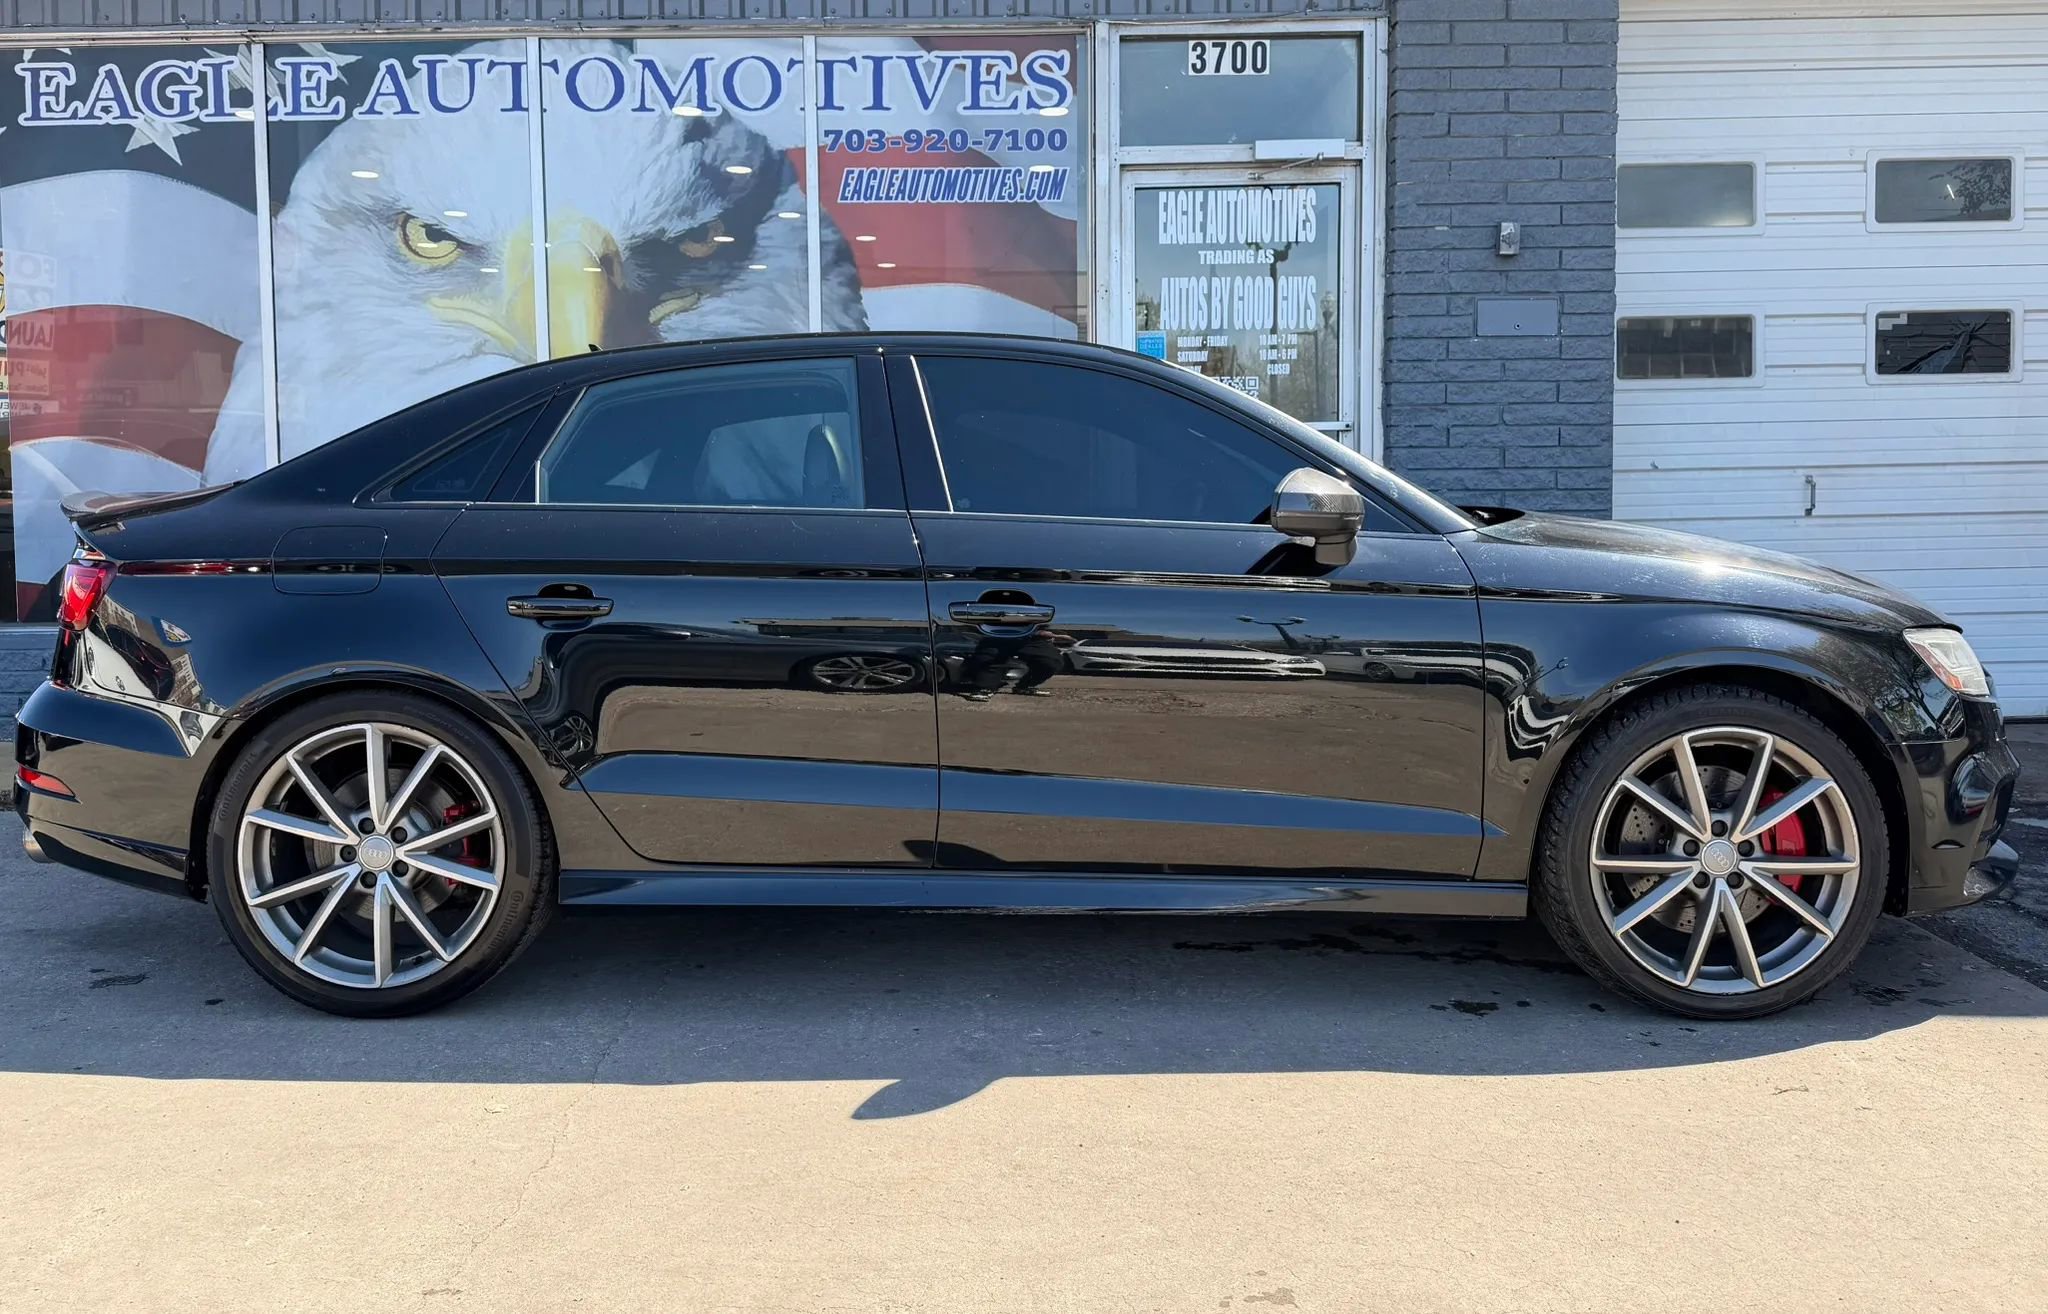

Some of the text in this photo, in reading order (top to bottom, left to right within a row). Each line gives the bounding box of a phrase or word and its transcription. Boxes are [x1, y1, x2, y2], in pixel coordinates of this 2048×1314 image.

[1190, 40, 1268, 75] 3700
[18, 54, 1070, 122] EAGLE AUTOMOTIVES
[823, 129, 1068, 152] 703-920-7100
[838, 167, 1068, 202] EAGLEAUTOMOTIVES.COM
[1158, 188, 1317, 245] EAGLE AUTOMOTIVES
[1198, 248, 1275, 265] TRADING AS
[1160, 275, 1317, 331] AUTOS BY GOOD GUYS
[1207, 335, 1229, 347] FRIDAY
[1259, 334, 1267, 345] 10
[1267, 334, 1278, 345] AM
[1287, 334, 1298, 345] PM
[1177, 350, 1209, 363] SATURDAY
[1259, 349, 1267, 361] 10
[1267, 349, 1278, 361] AM
[1287, 348, 1298, 360] PM
[1267, 363, 1291, 375] CLOSED
